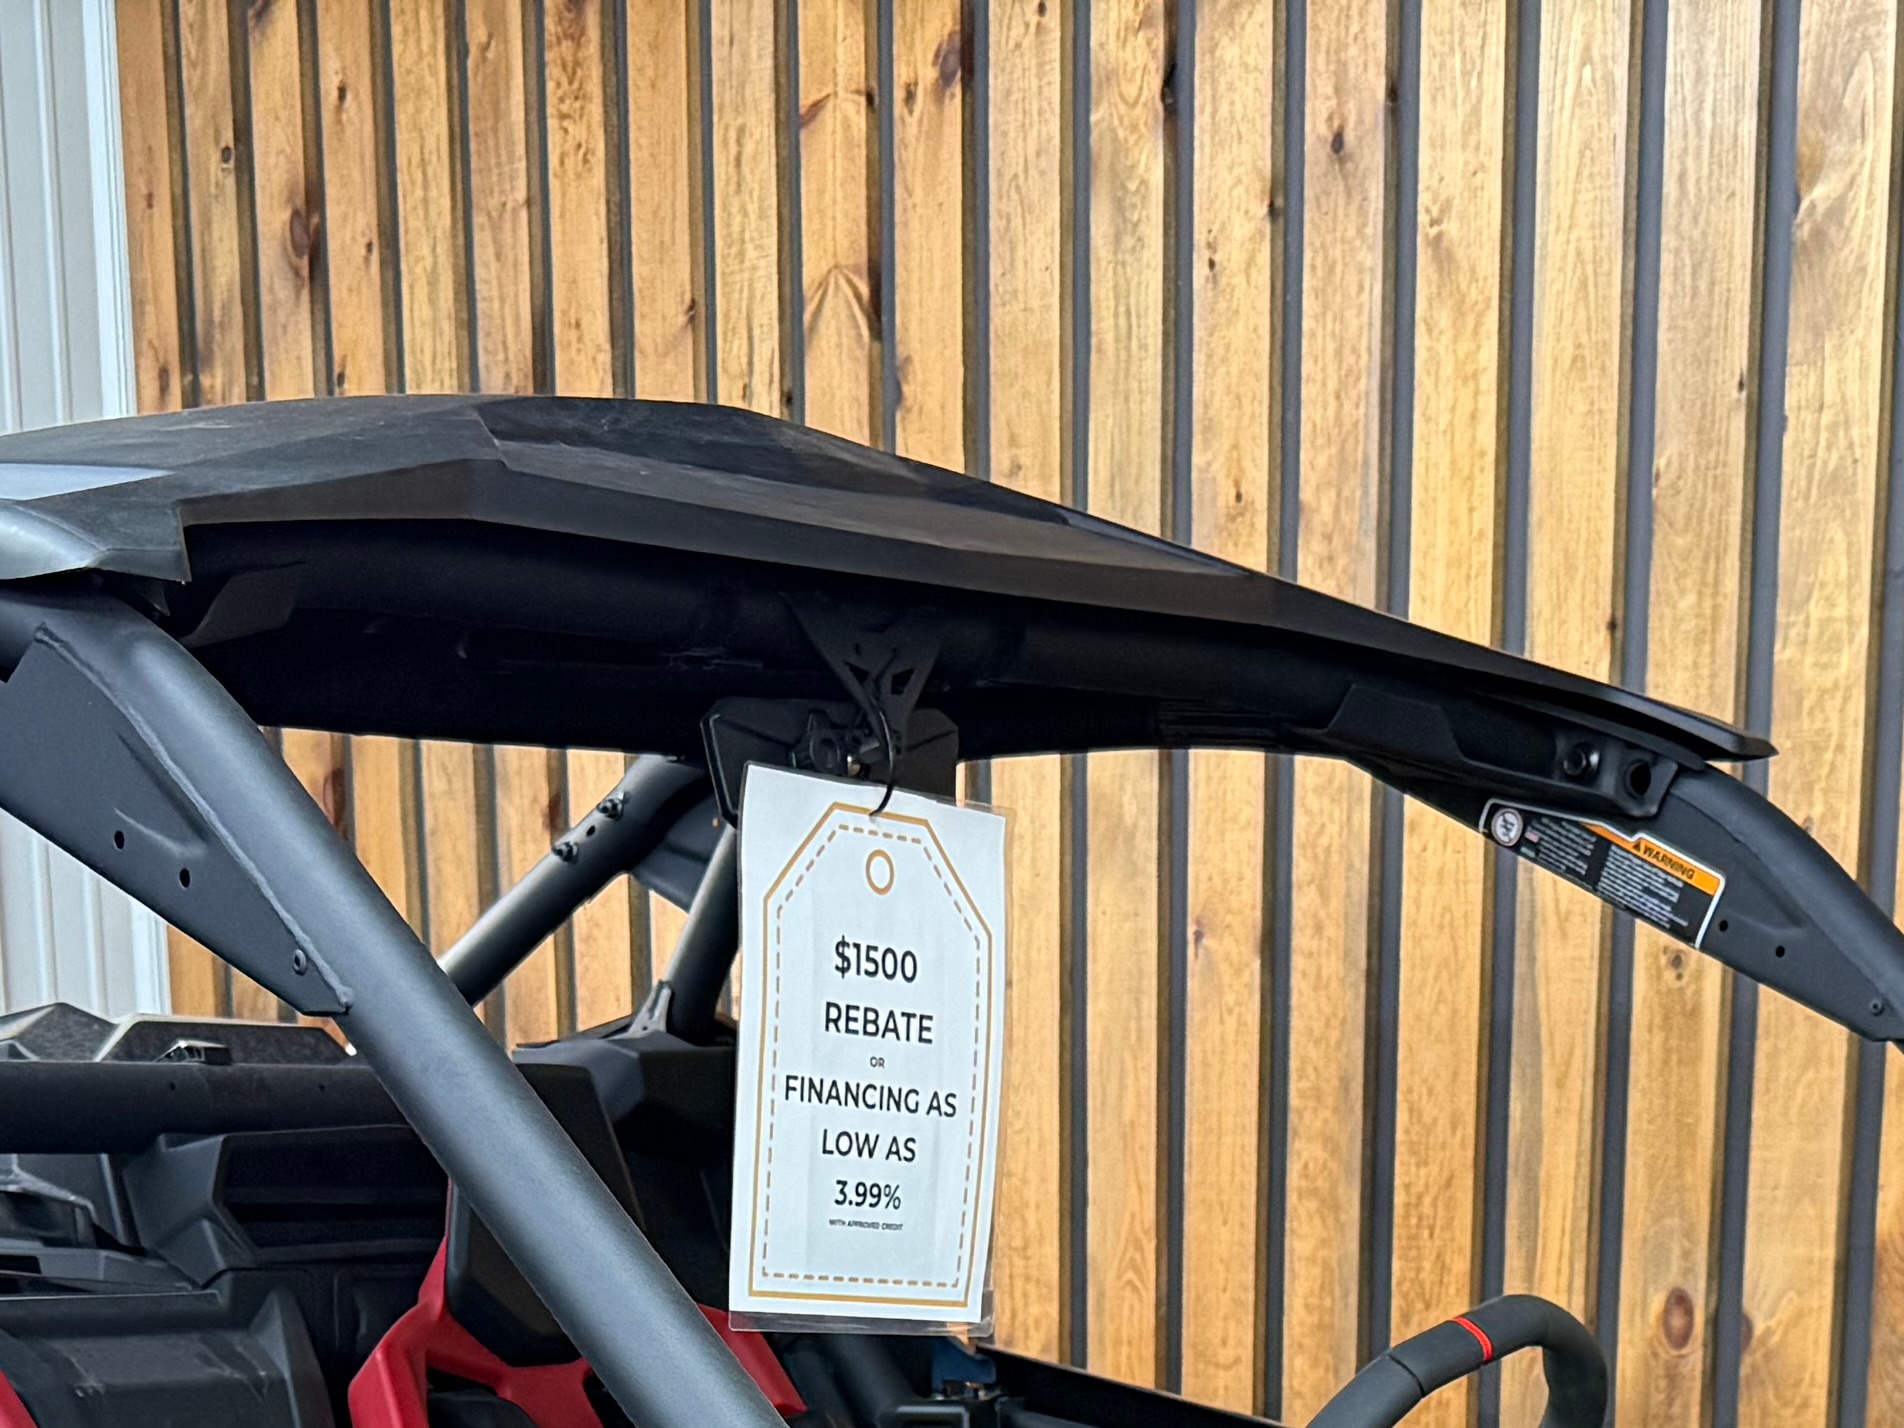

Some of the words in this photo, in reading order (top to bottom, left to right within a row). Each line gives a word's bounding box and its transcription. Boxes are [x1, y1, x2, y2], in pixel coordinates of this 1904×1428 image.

[1643, 844, 1696, 880] WARNING
[834, 935, 918, 985] $1500
[824, 1001, 934, 1045] REBATE
[869, 1057, 886, 1070] OR
[784, 1075, 921, 1116] FINANCING
[926, 1092, 958, 1119] AS
[822, 1128, 881, 1160] LOW
[885, 1135, 917, 1163] AS
[833, 1179, 903, 1211] 3.99%
